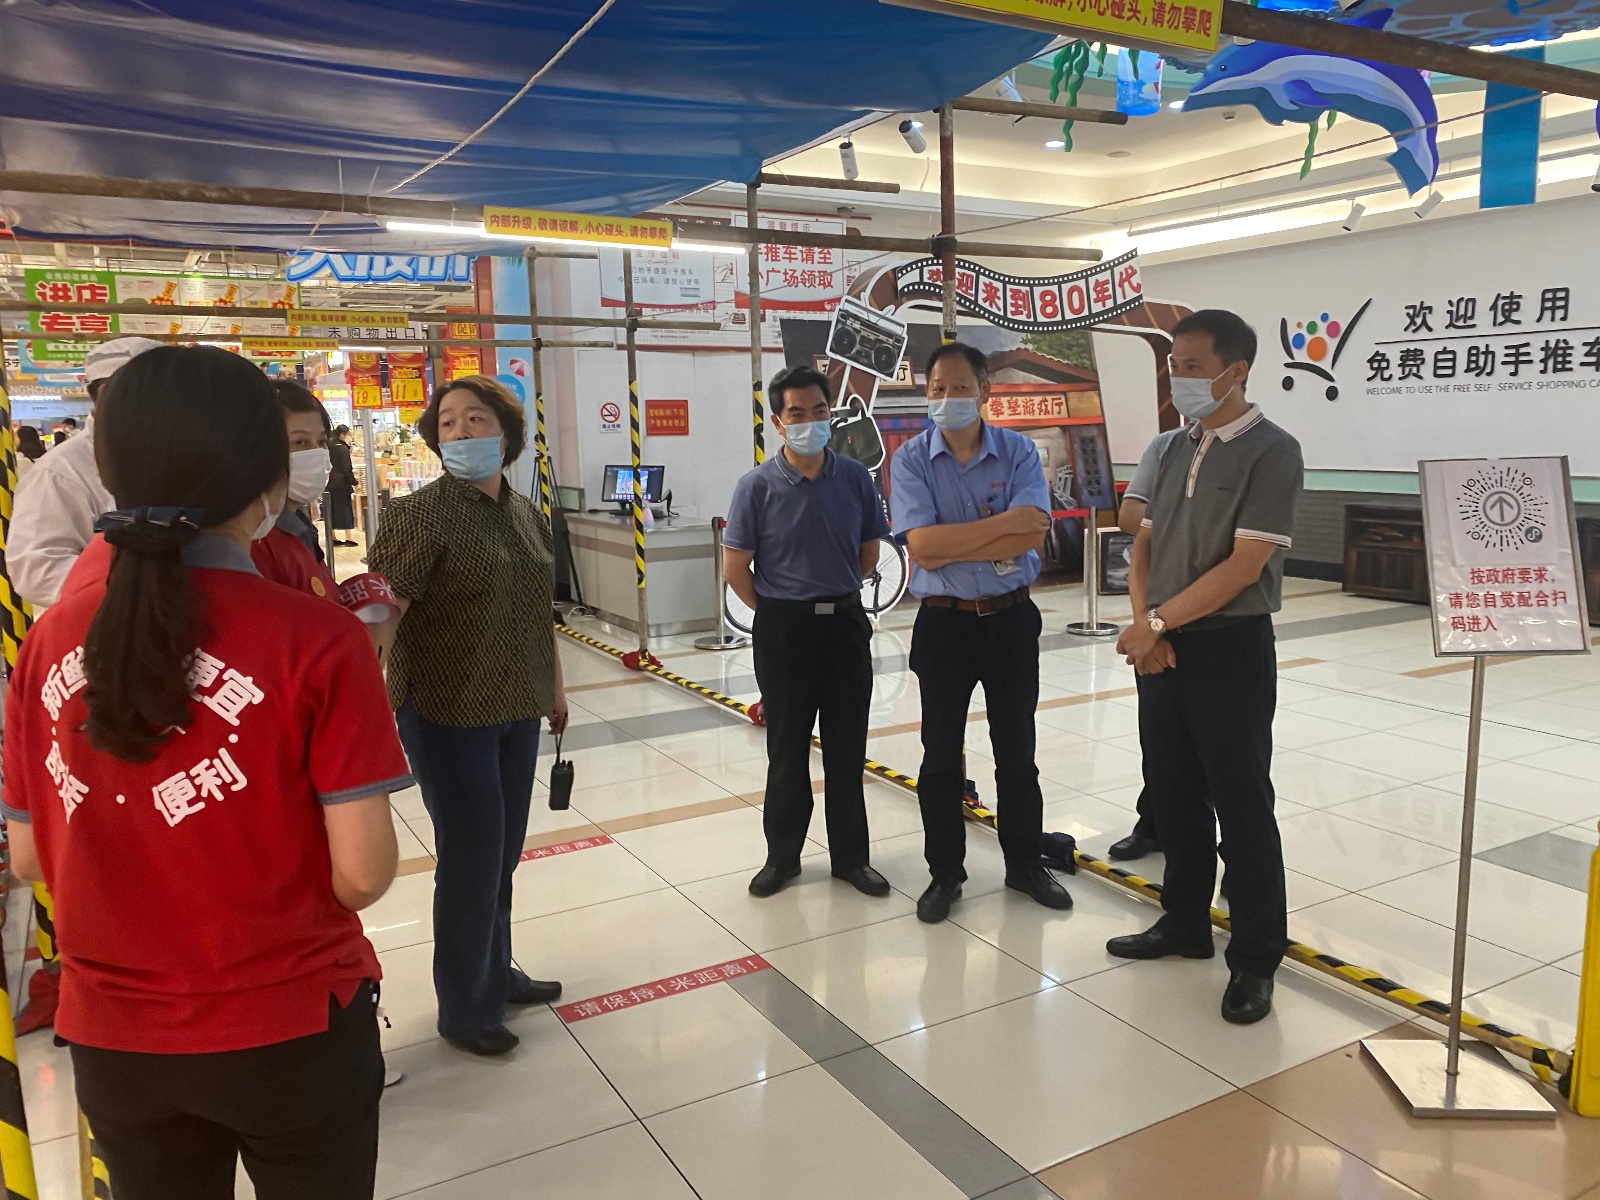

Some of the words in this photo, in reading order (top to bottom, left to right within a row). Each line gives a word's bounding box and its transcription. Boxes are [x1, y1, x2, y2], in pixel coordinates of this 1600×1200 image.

[1026, 0, 1213, 37] ,小心碰头,请勿攀爬
[758, 267, 834, 289] 广场领取
[927, 264, 1142, 320] 欢迎来到80年代
[1403, 287, 1570, 334] 欢迎使用
[1366, 387, 1402, 395] WELCOME
[1405, 386, 1416, 394] TO
[1418, 385, 1433, 394] USE
[1435, 384, 1451, 393] THE
[1453, 384, 1472, 393] FREE
[1474, 383, 1492, 392] SELF
[1497, 381, 1533, 391] SERVICE
[1536, 380, 1587, 390] SHOPPING
[1449, 589, 1568, 609] 请您自觉配合扫
[1451, 615, 1498, 632] 码进入
[152, 748, 248, 828] 便利
[573, 959, 758, 1017] 请保持1米距离!
